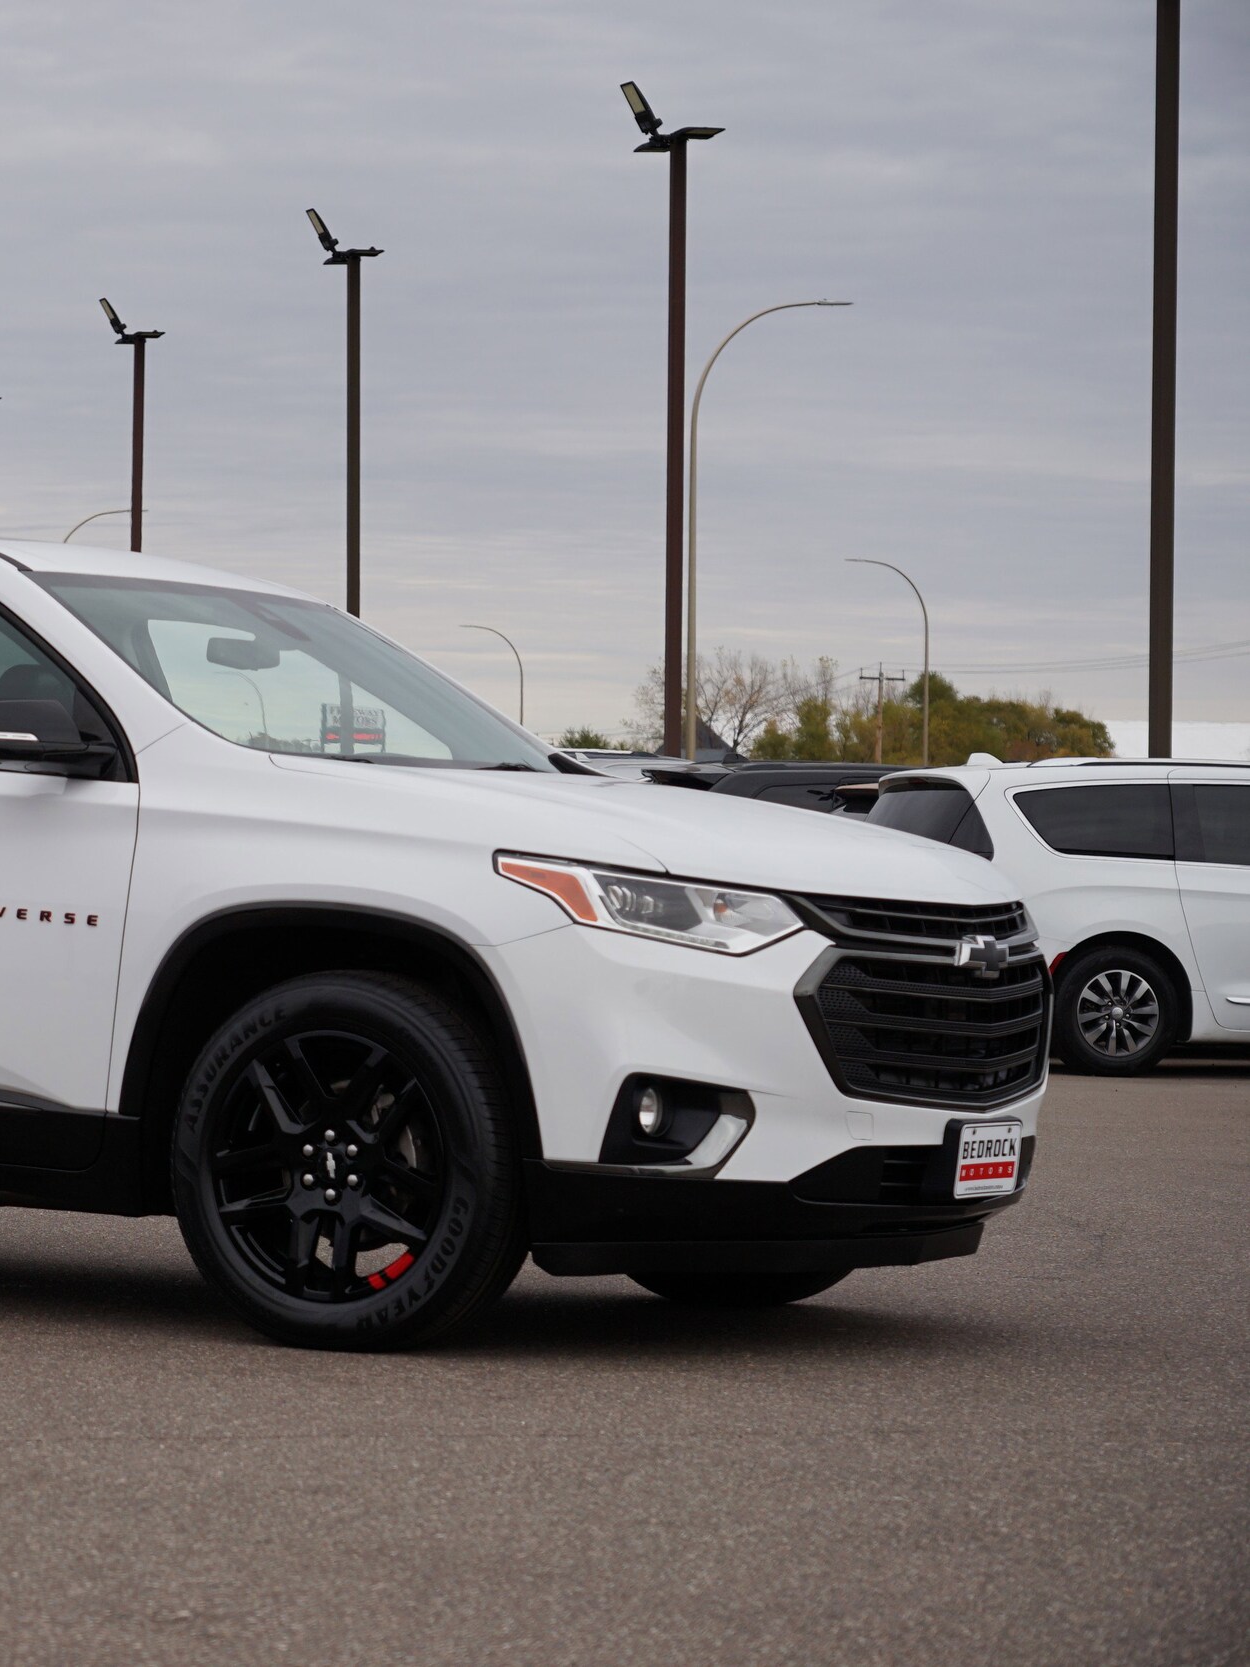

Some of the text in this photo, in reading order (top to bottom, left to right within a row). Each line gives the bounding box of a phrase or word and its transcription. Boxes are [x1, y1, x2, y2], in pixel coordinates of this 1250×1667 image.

[185, 1004, 289, 1134] ASSURANCE
[961, 1165, 1013, 1177] MOTORS
[962, 1138, 1017, 1159] BEDROCK
[356, 1195, 471, 1331] GOODYEAR
